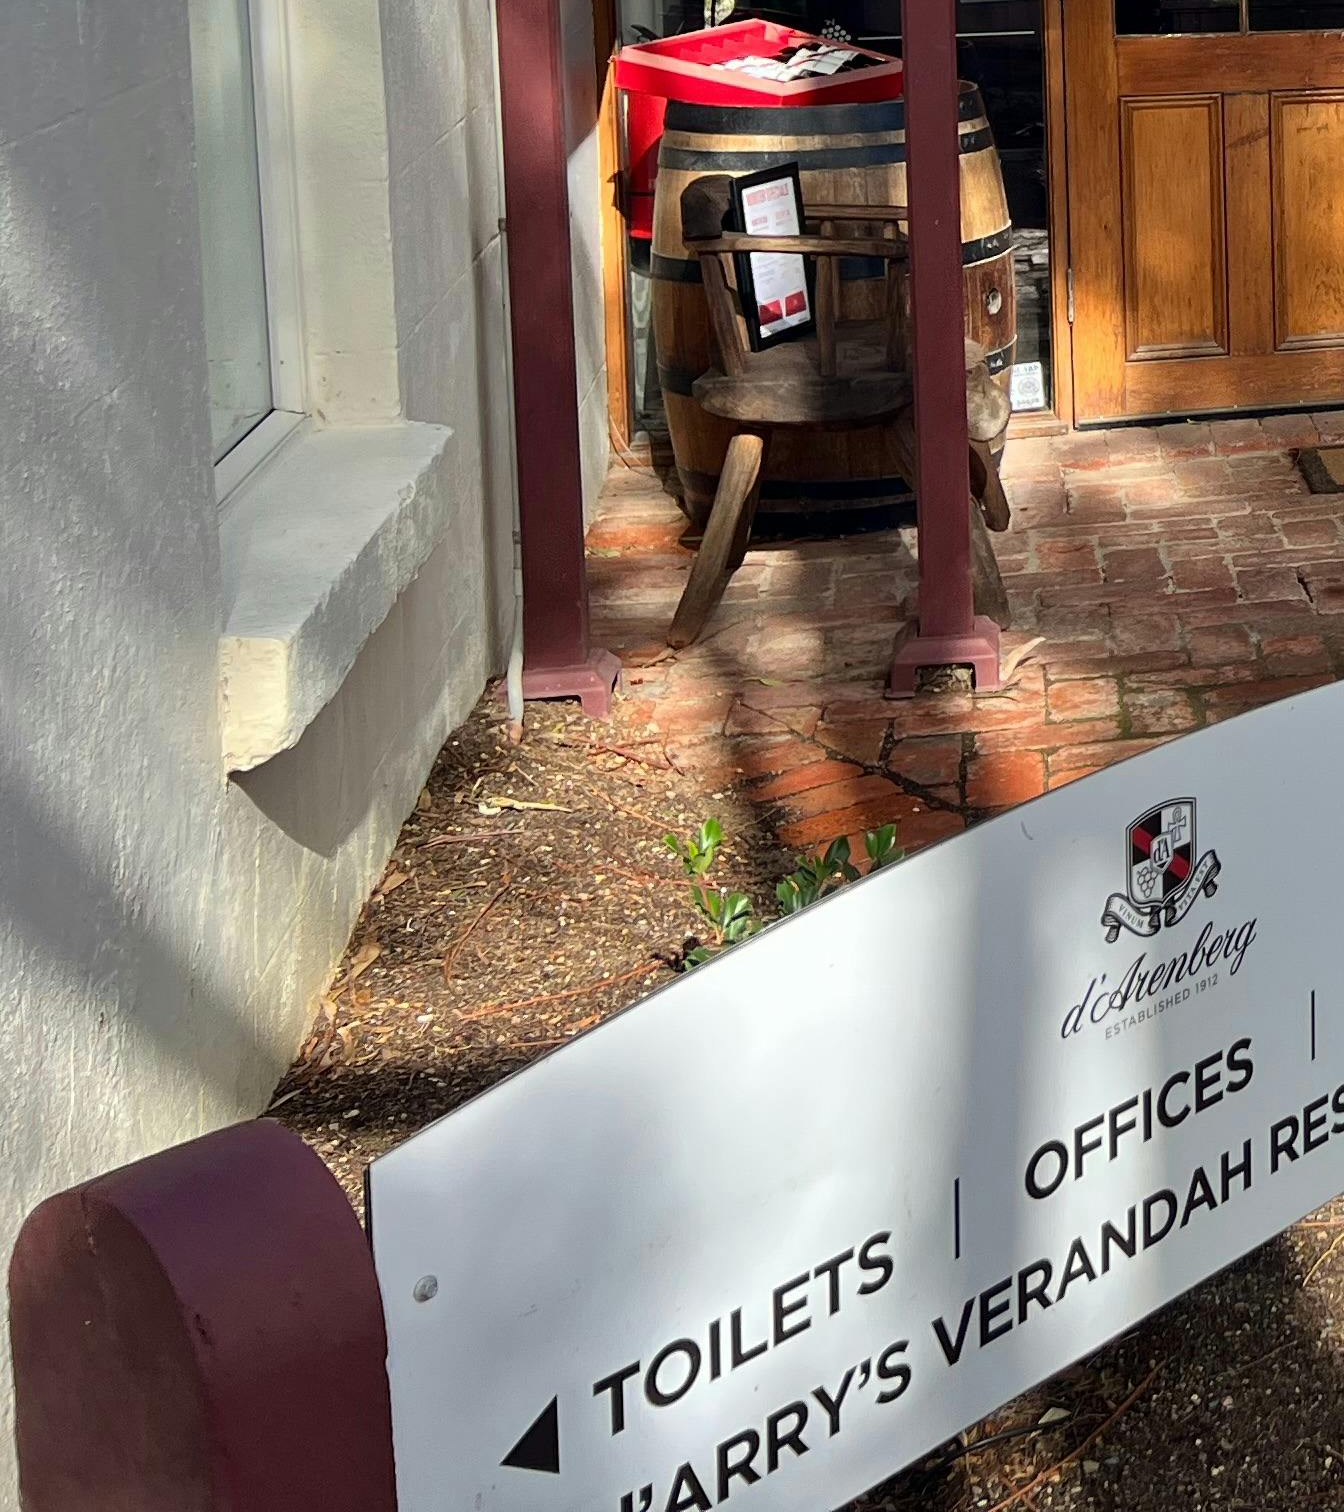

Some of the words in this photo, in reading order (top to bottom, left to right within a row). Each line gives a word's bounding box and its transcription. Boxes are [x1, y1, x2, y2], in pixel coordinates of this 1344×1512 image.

[1118, 903, 1144, 928] VINUM
[1061, 918, 1258, 1039] d'Arenberg
[1105, 989, 1191, 1040] ESTABLISHED
[1195, 973, 1219, 994] 1912
[592, 1231, 895, 1437] TOILETS
[1024, 1036, 1254, 1200] OFFICES
[930, 1138, 1252, 1367] VERANDAH
